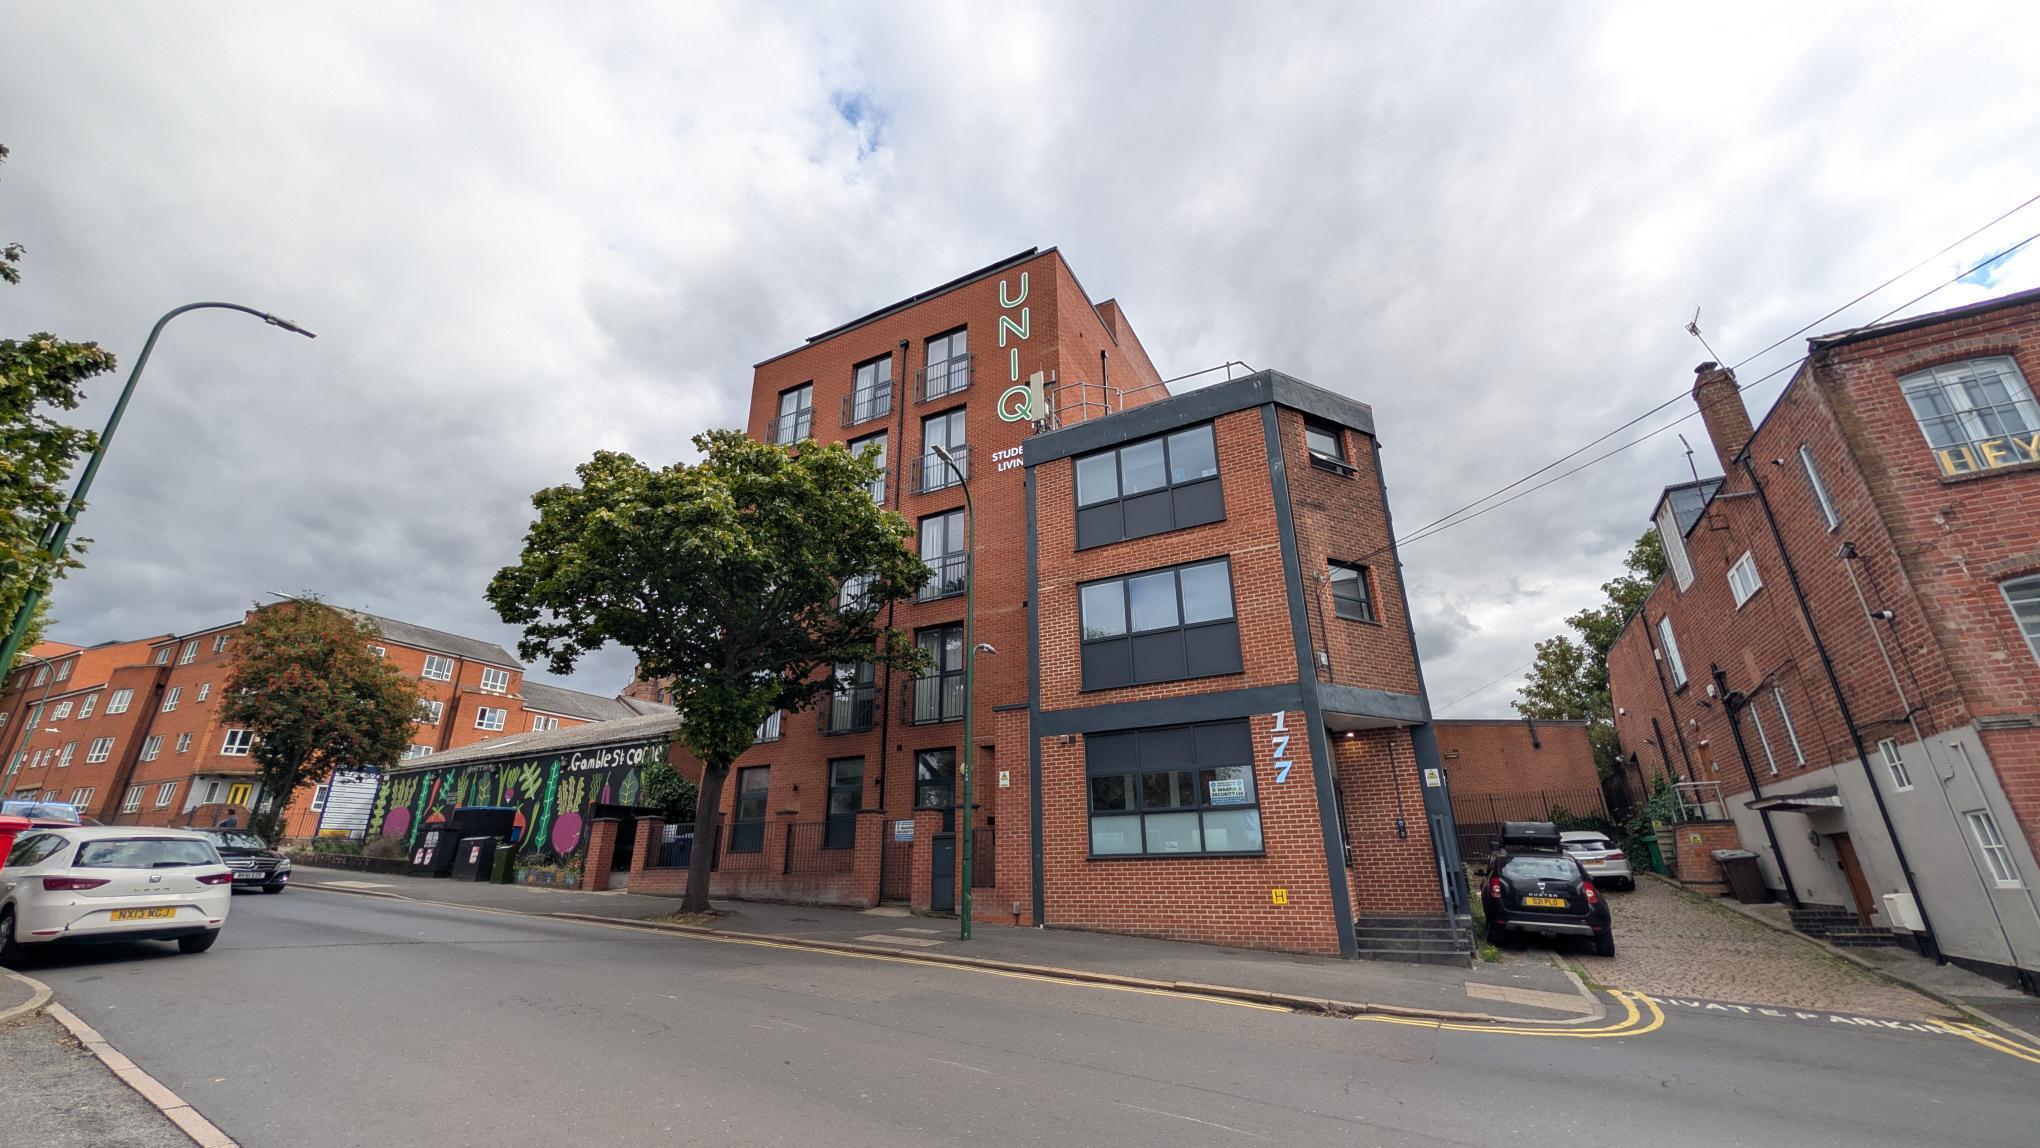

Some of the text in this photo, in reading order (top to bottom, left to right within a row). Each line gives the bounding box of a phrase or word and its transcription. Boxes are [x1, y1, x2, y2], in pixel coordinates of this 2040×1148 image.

[998, 272, 1032, 422] UNIQ
[992, 445, 1024, 462] STUDE
[998, 458, 1024, 472] LIVIN
[1270, 710, 1292, 784] 177
[570, 749, 611, 771] Gamble
[1275, 890, 1285, 903] H
